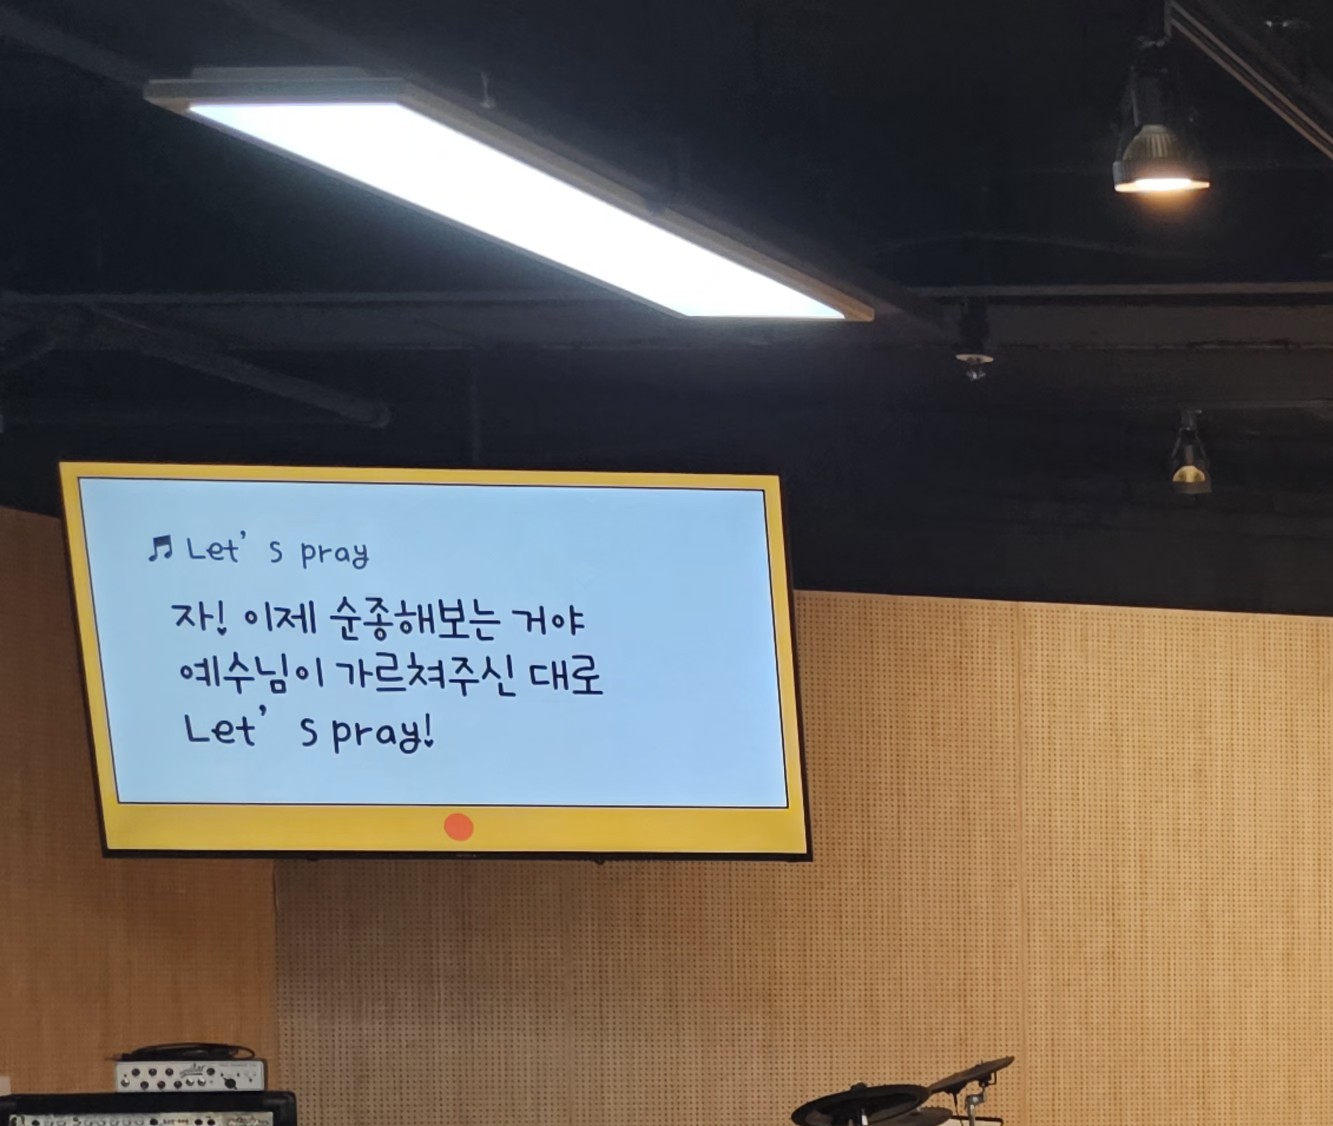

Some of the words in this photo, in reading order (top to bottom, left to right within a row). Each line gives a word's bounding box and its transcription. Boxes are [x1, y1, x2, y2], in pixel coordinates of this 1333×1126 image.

[301, 542, 370, 570] pray
[170, 599, 228, 636] 자!
[244, 599, 317, 635] 이제
[329, 595, 502, 642] 순종해보는
[511, 604, 585, 636] 거야
[179, 652, 325, 695] 예수님이
[335, 651, 517, 698] 가르쳐주신
[528, 654, 604, 697] 대로
[331, 712, 436, 755] pray!
